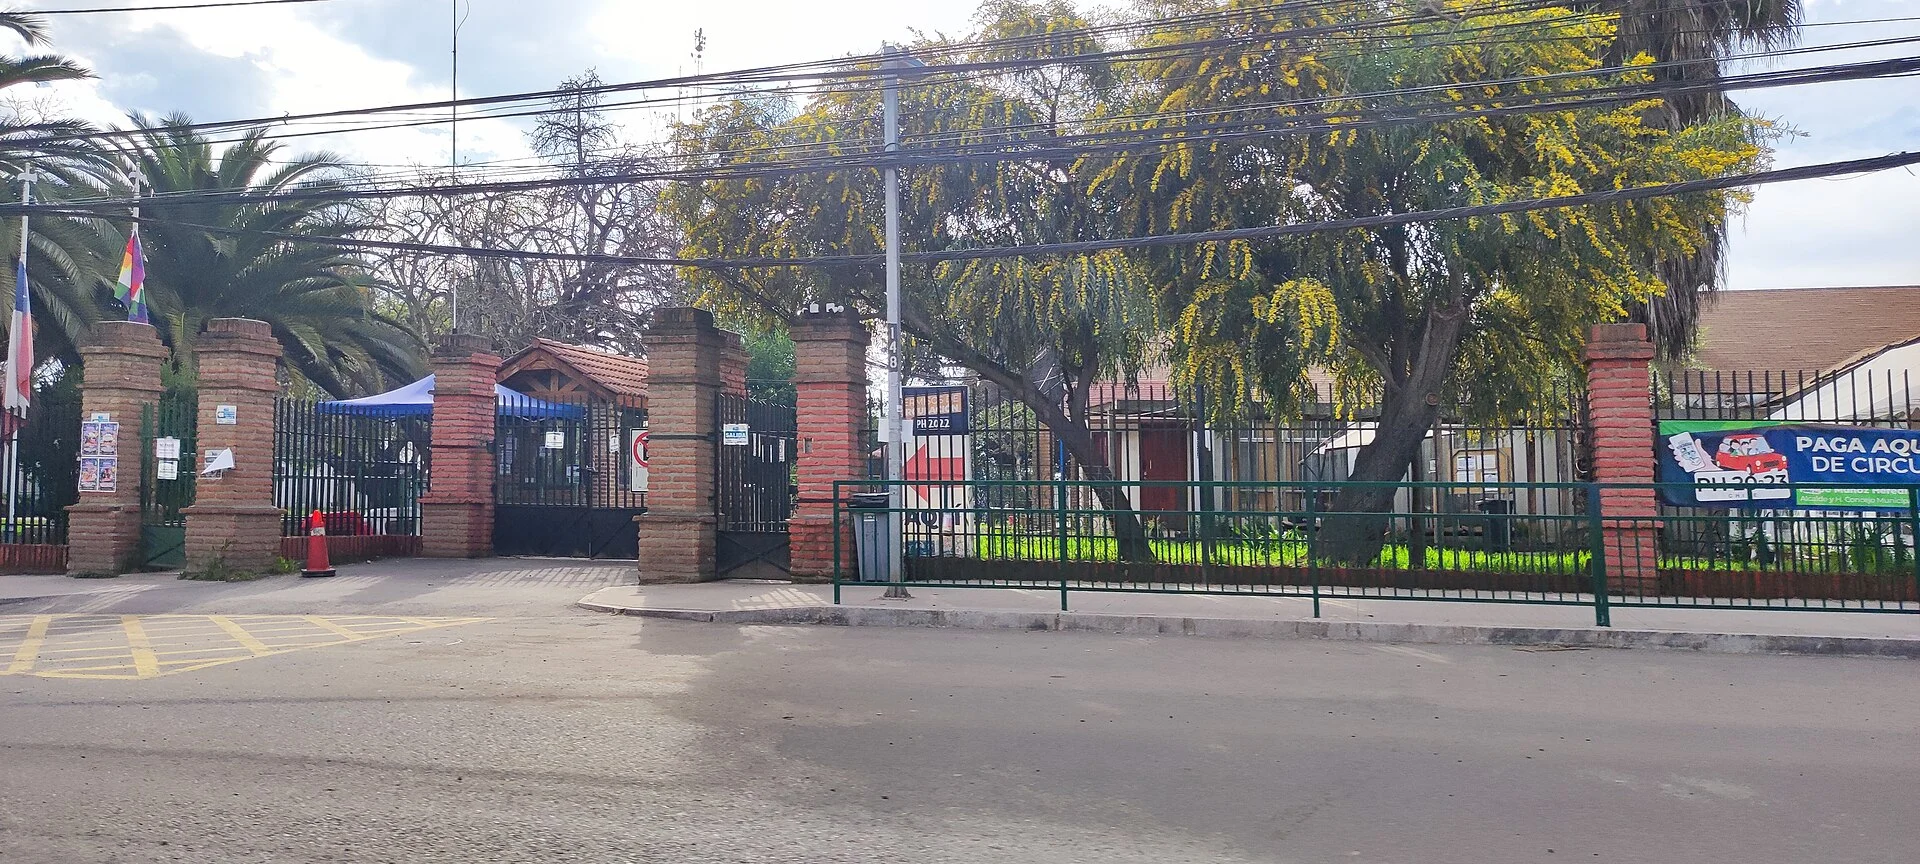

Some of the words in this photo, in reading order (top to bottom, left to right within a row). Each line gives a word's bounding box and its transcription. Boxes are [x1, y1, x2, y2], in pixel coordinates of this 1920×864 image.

[889, 327, 897, 368] 148
[917, 419, 927, 429] PH
[928, 419, 950, 428] 2022
[1796, 437, 1866, 453] PAGA
[1812, 457, 1845, 472] DE
[1851, 457, 1920, 474] CIRCU
